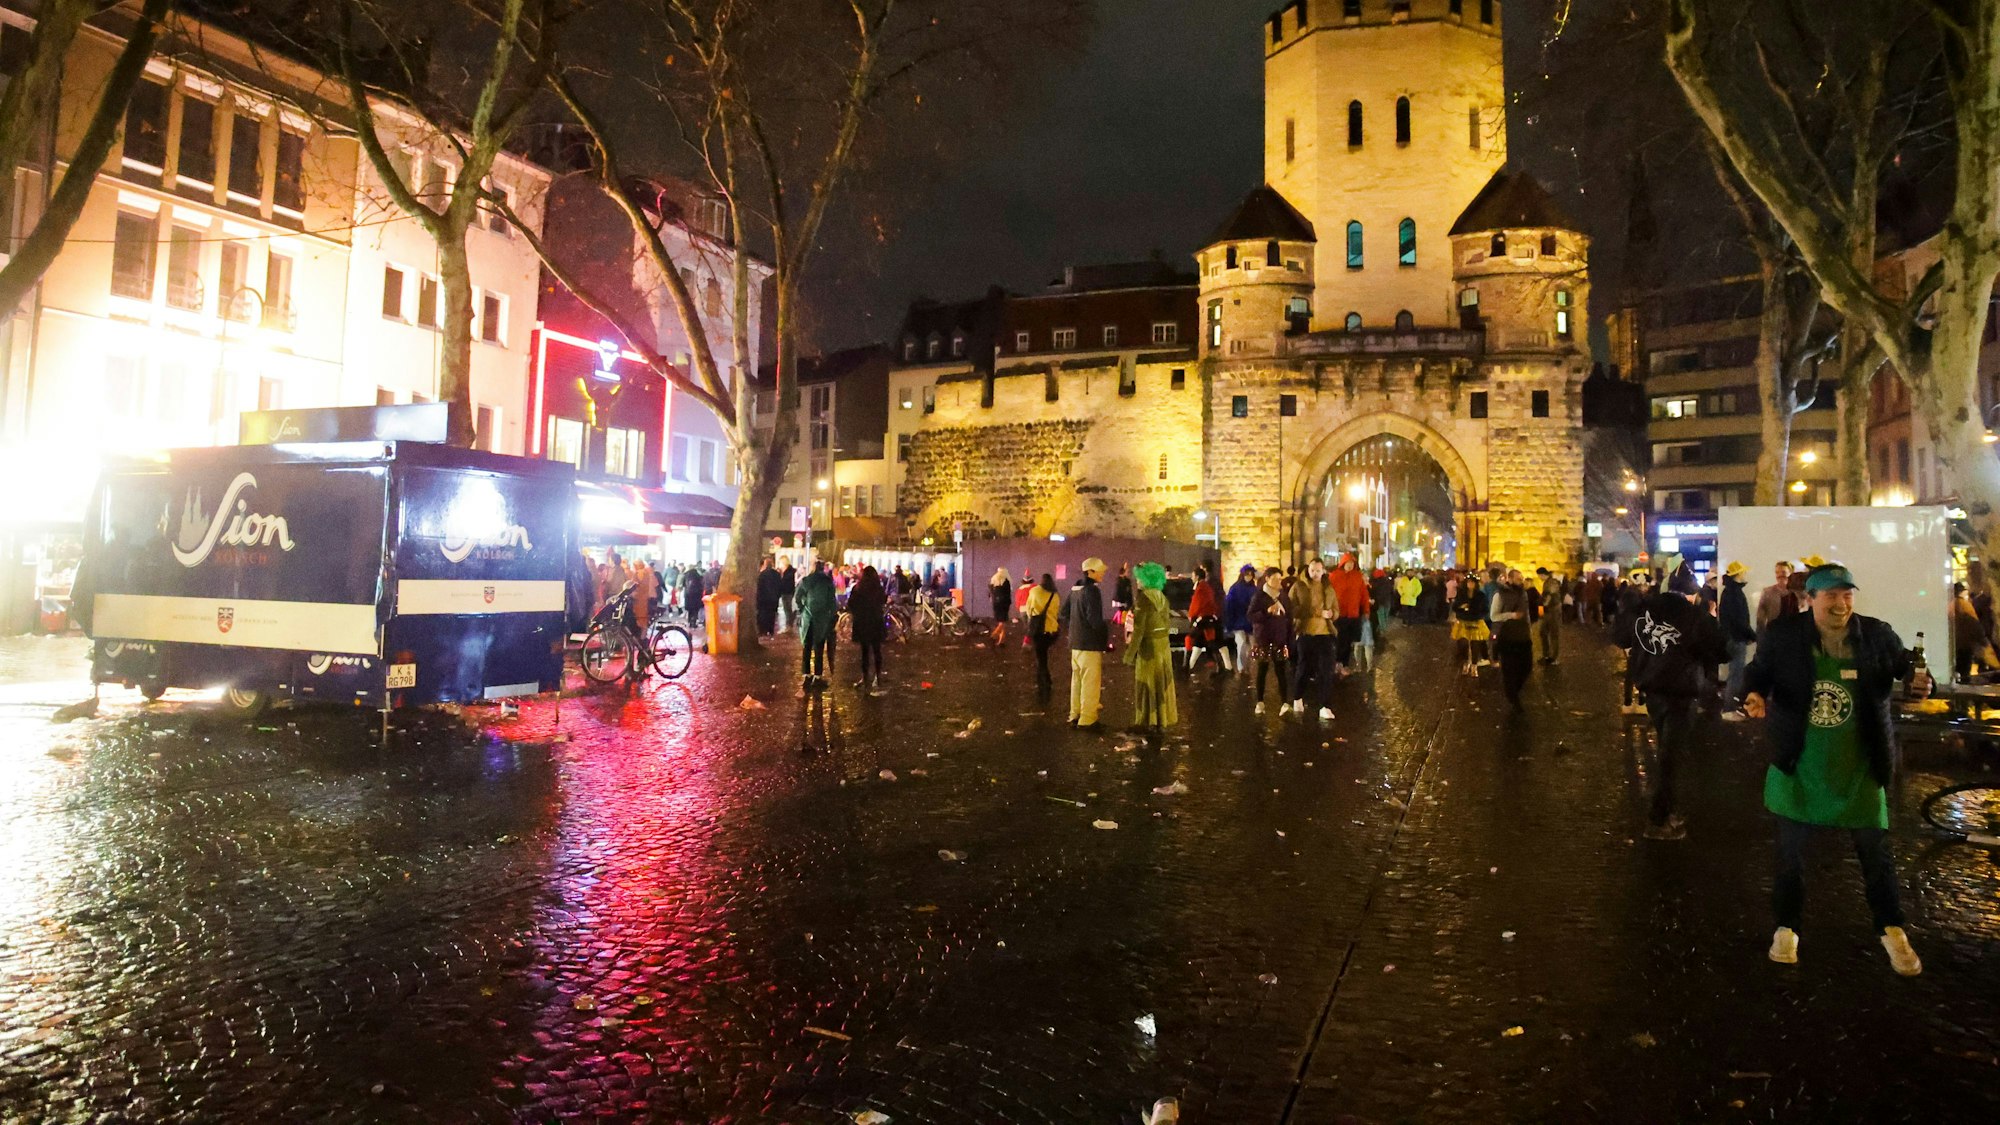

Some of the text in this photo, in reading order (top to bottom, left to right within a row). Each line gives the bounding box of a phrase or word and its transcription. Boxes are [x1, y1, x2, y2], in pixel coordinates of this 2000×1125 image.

[171, 472, 296, 568] Sion
[397, 666, 403, 675] K
[1813, 682, 1850, 704] RBUCKS
[1811, 715, 1843, 725] OFFEE
